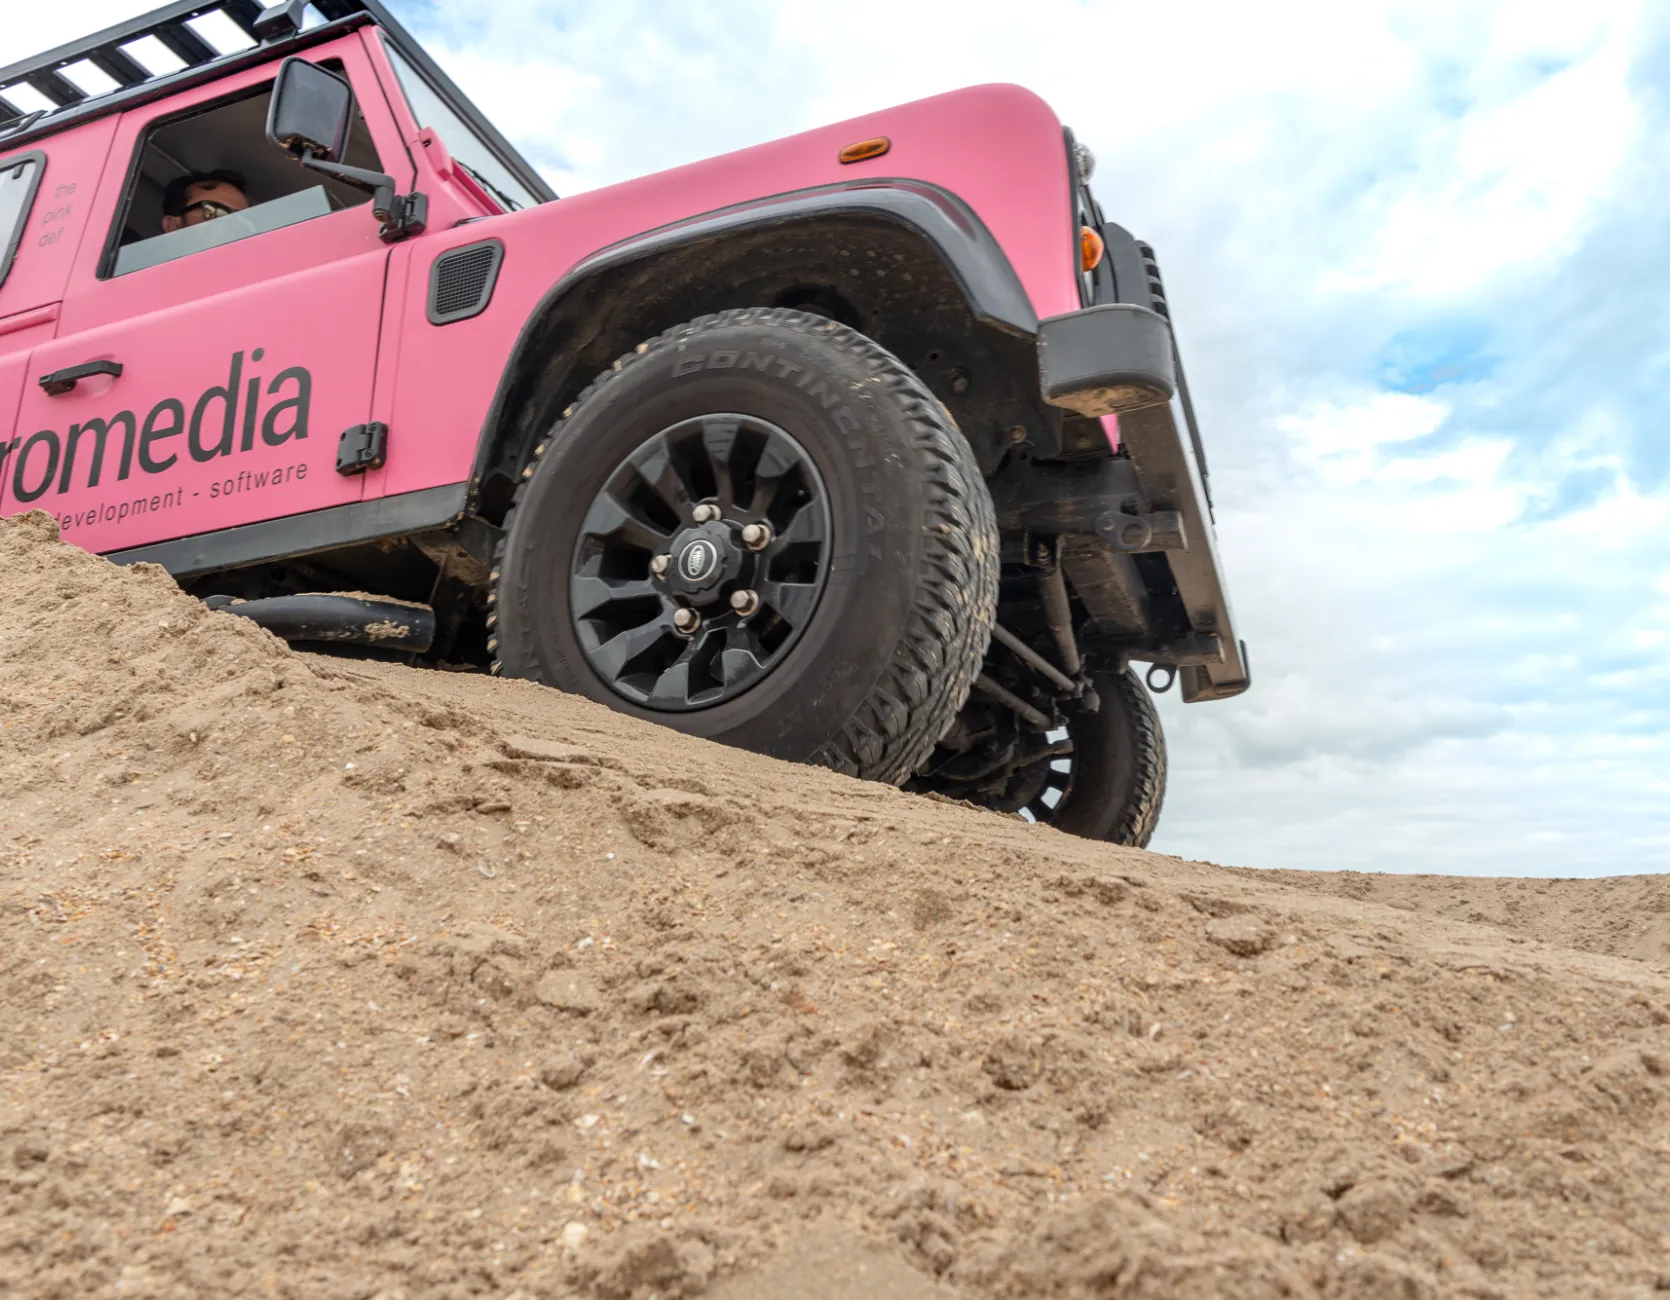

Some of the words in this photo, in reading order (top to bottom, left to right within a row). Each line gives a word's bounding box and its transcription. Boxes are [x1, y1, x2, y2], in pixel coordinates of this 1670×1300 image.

[54, 181, 77, 198] the
[41, 202, 72, 228] pink
[38, 226, 65, 247] def
[210, 463, 308, 498] software
